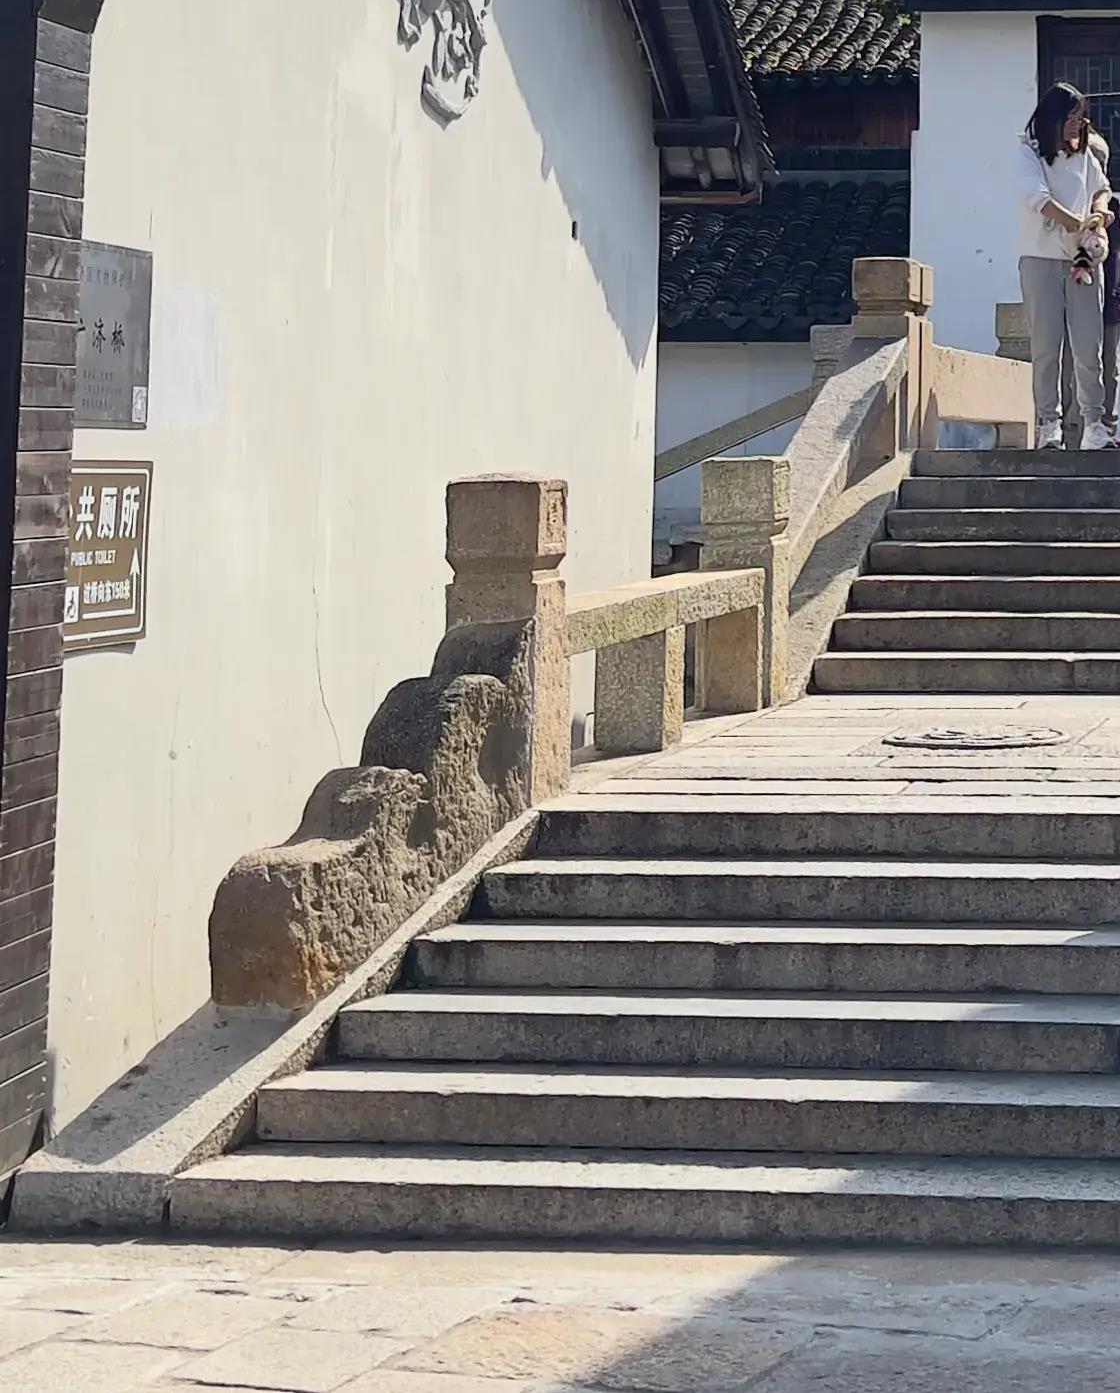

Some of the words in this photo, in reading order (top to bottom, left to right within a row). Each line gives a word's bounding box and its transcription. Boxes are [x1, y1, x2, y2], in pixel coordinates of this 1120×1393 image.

[69, 485, 141, 542] 共厕所
[70, 551, 94, 567] PUBLIC
[94, 549, 117, 565] TOILET
